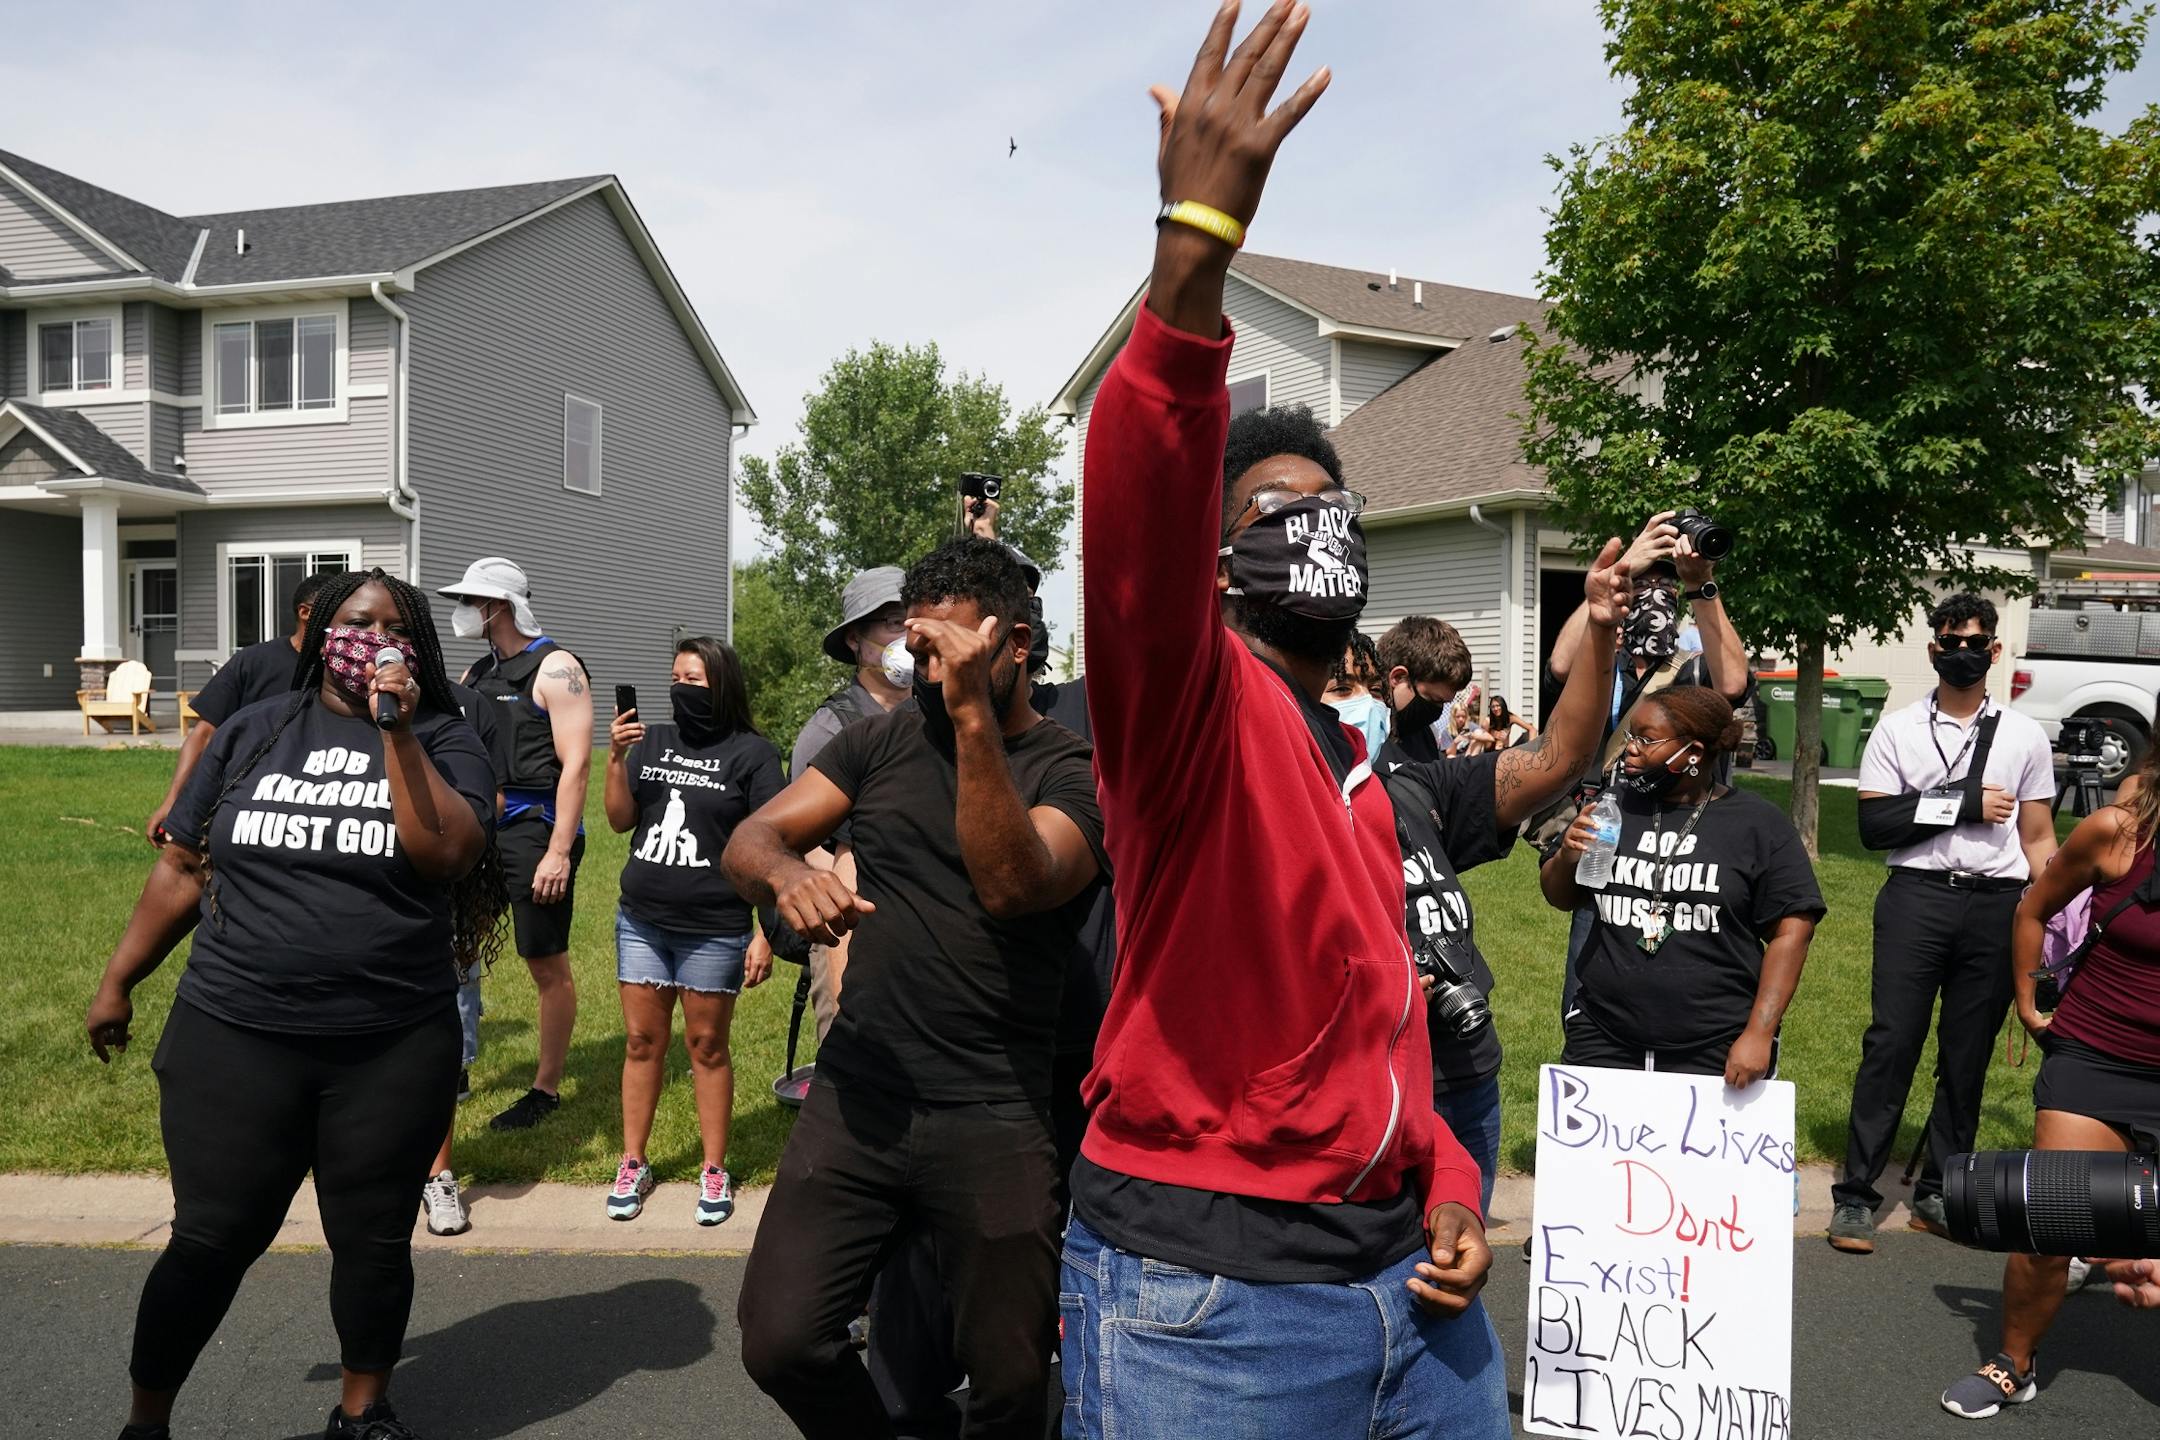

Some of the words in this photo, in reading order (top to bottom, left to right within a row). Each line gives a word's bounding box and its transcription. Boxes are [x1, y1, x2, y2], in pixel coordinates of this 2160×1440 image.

[1285, 507, 1355, 544] BLACK
[1288, 563, 1361, 597] MATTER
[302, 747, 371, 776] BOB
[640, 765, 726, 791] BITCHES...
[660, 748, 674, 762] I
[672, 755, 721, 772] smell
[251, 773, 392, 810] KKKROLL
[231, 810, 332, 851] MUST
[336, 817, 396, 858] GO!
[1637, 831, 1698, 857] BOB
[1672, 901, 1721, 933] GO!
[1542, 1067, 1667, 1154] Blue
[1680, 1085, 1796, 1173] Lives
[1613, 1159, 1754, 1252] Dont
[1542, 1225, 1690, 1303] Exist!
[1534, 1286, 1717, 1370] BLACK
[1529, 1356, 1684, 1440] LIVES
[1694, 1383, 1791, 1440] MATTER
